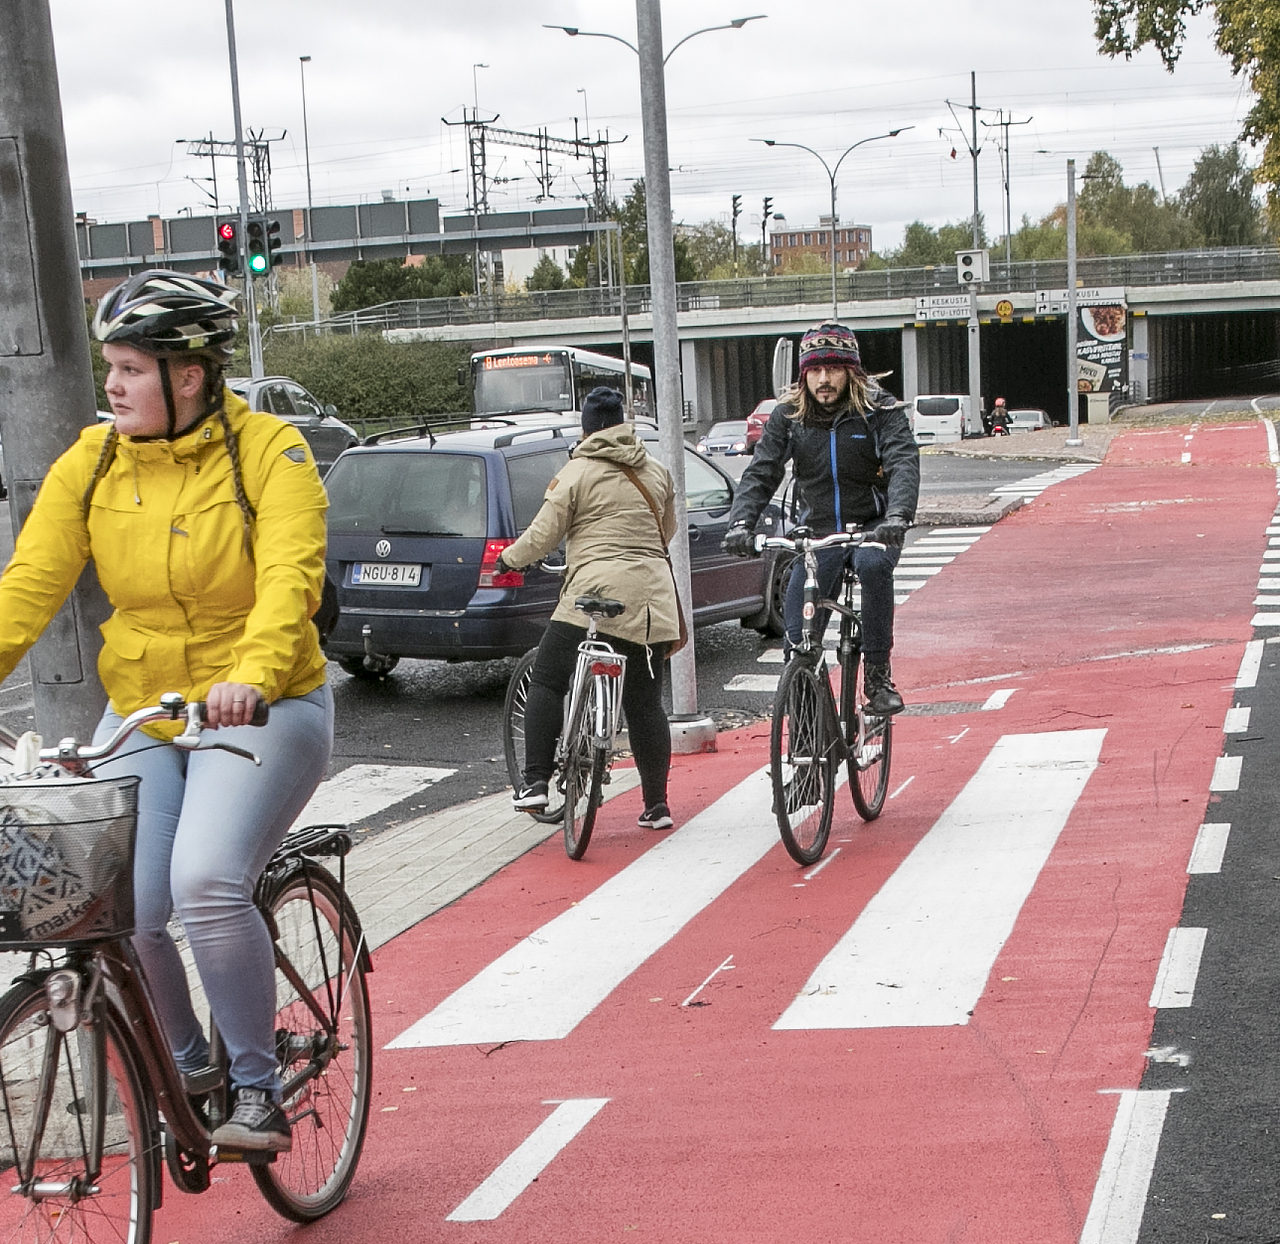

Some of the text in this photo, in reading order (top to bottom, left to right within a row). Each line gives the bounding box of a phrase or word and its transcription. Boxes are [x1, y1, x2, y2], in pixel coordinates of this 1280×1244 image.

[1062, 290, 1100, 299] KKUSTA
[931, 297, 968, 306] KESKUSTA
[493, 355, 539, 369] Lentoasema
[362, 566, 416, 582] NGU-814
